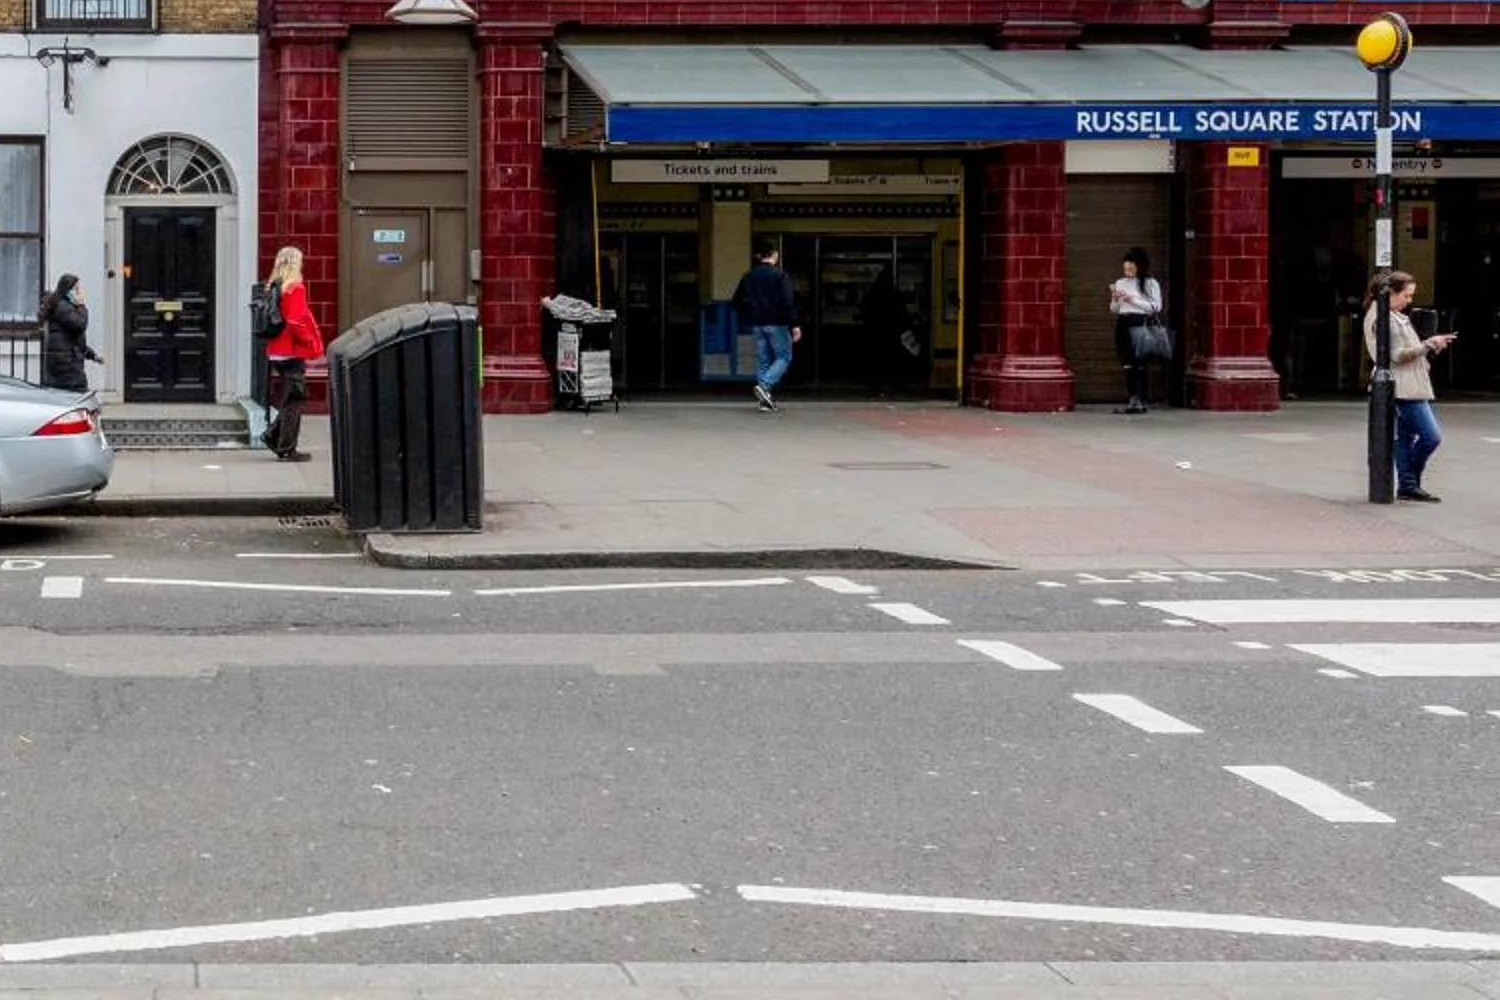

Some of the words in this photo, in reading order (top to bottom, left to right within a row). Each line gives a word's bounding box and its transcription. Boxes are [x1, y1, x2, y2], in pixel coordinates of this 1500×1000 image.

[1076, 110, 1182, 132] RUSSELL
[1195, 110, 1300, 132] SQUARE
[664, 162, 710, 175] Tickets
[714, 162, 738, 175] and
[741, 162, 778, 175] trains
